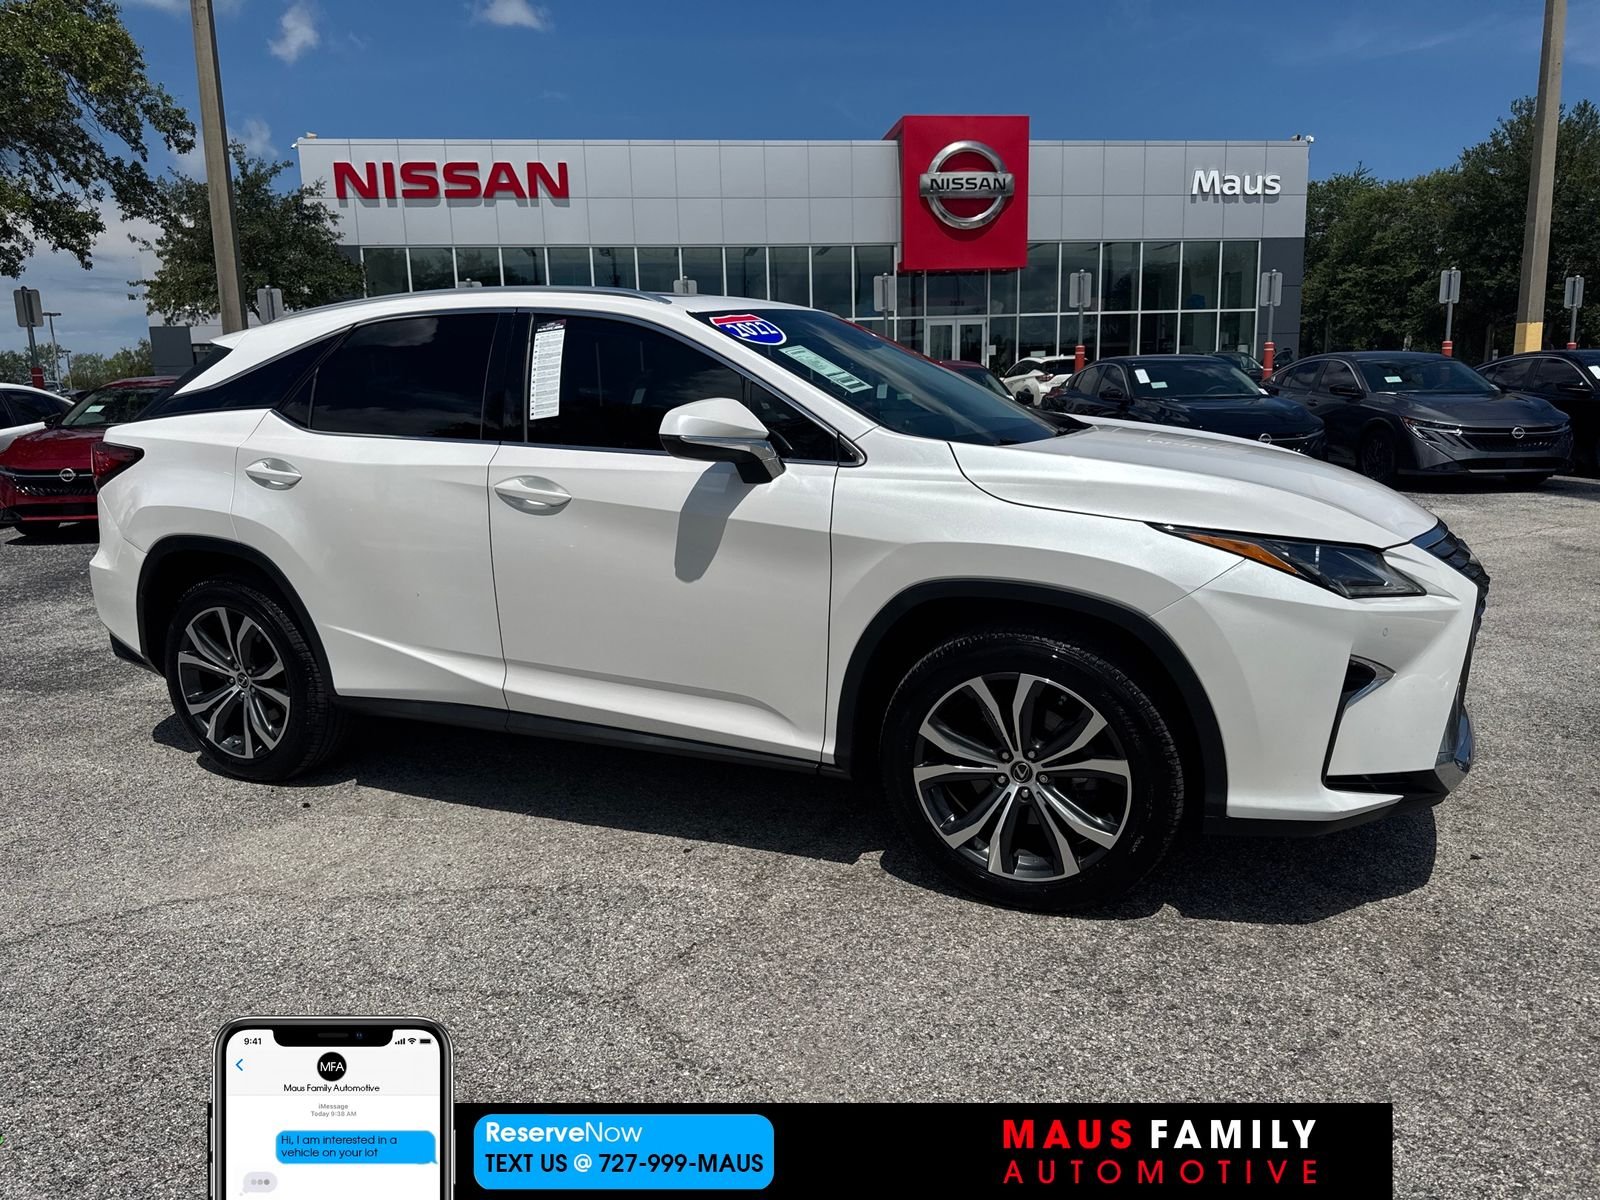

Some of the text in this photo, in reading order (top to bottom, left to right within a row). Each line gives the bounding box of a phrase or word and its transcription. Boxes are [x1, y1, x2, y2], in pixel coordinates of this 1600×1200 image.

[333, 161, 570, 199] NISSAN
[929, 177, 1006, 191] NISSAN
[1191, 169, 1281, 195] Maus
[725, 321, 779, 338] 2022
